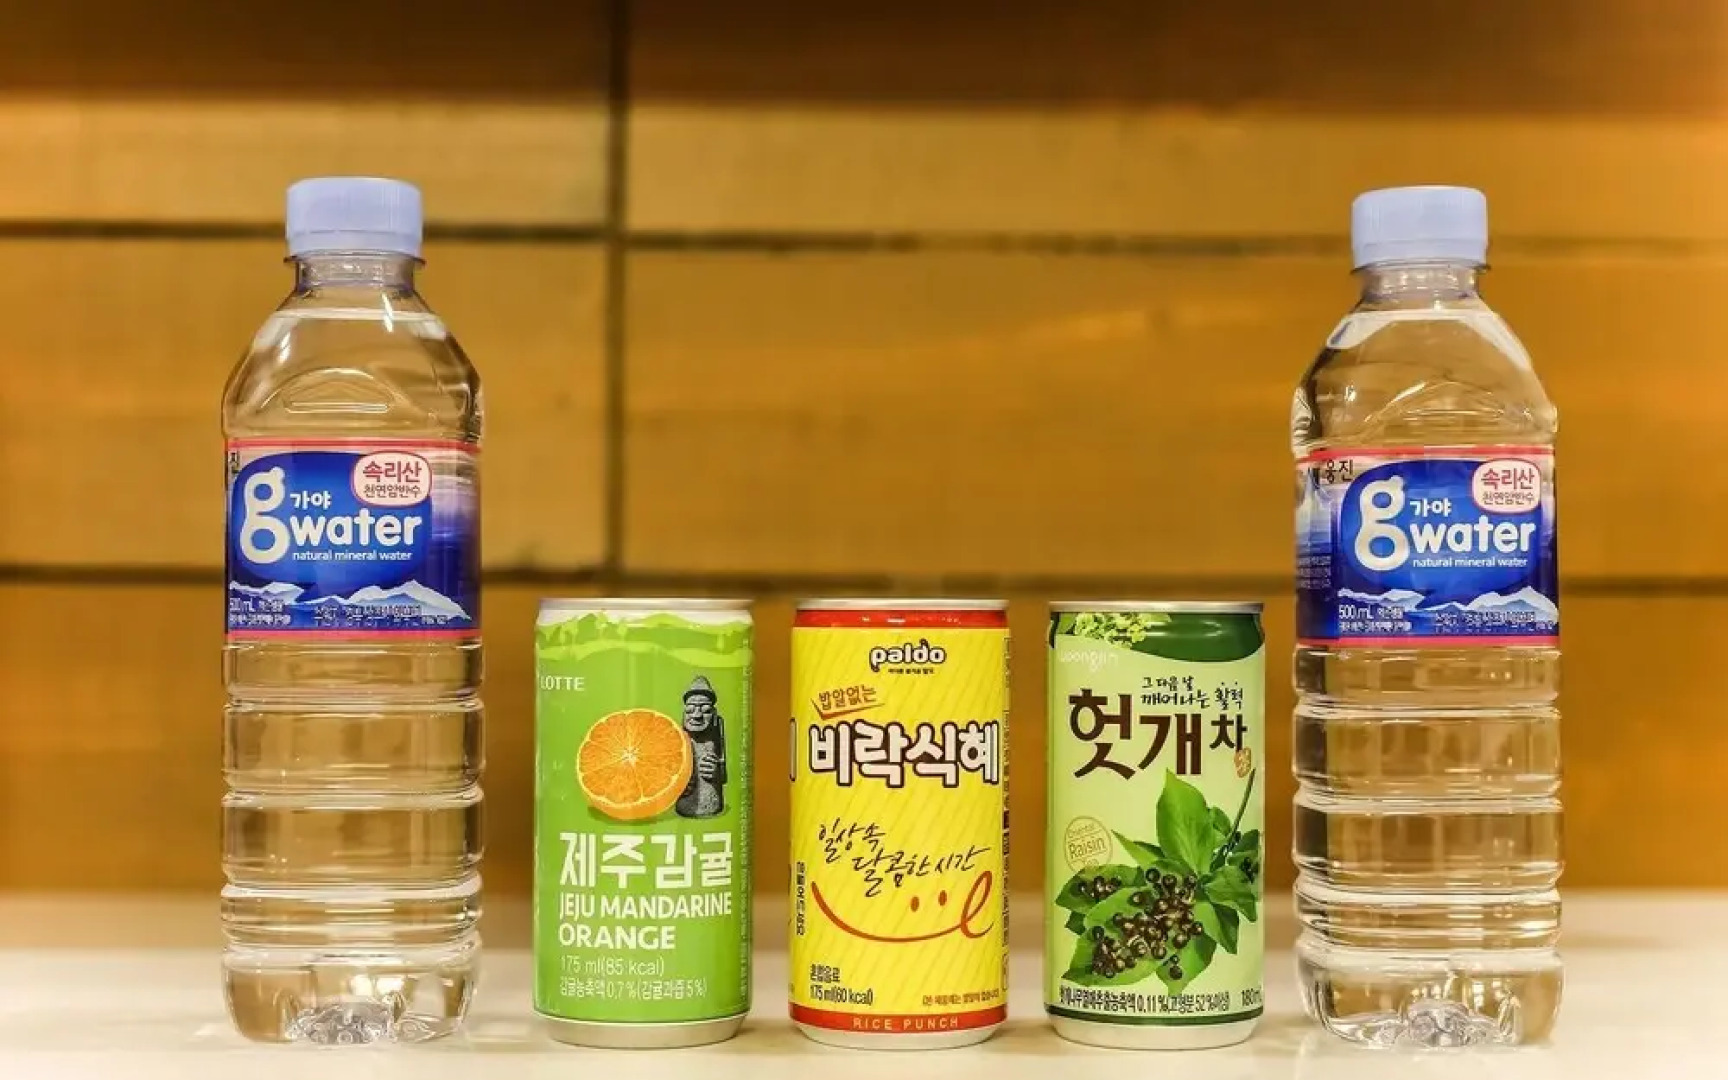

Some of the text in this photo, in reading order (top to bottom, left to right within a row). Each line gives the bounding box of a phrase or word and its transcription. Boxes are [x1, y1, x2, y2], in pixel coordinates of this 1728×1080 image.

[362, 461, 422, 482] 속리산
[1324, 460, 1354, 482] 웅진
[1481, 468, 1535, 489] 속리산
[290, 490, 332, 510] 가야
[1409, 498, 1452, 517] 가야
[292, 550, 413, 561] natural mineral water
[1413, 557, 1528, 567] natural mineral water
[1338, 604, 1355, 619] 500
[869, 638, 947, 672] paldo
[540, 675, 585, 691] LOTTE
[1140, 689, 1210, 709] 깨어나는
[1068, 687, 1248, 781] 헛개차
[809, 718, 1000, 788] 비락식혜
[1067, 838, 1105, 860] Raisin
[559, 832, 733, 889] 제주감귤
[559, 891, 732, 921] JEJU MANDARINE
[558, 922, 677, 950] ORANGE
[561, 955, 581, 974] 175
[852, 1016, 959, 1031] RICE PUNCH
